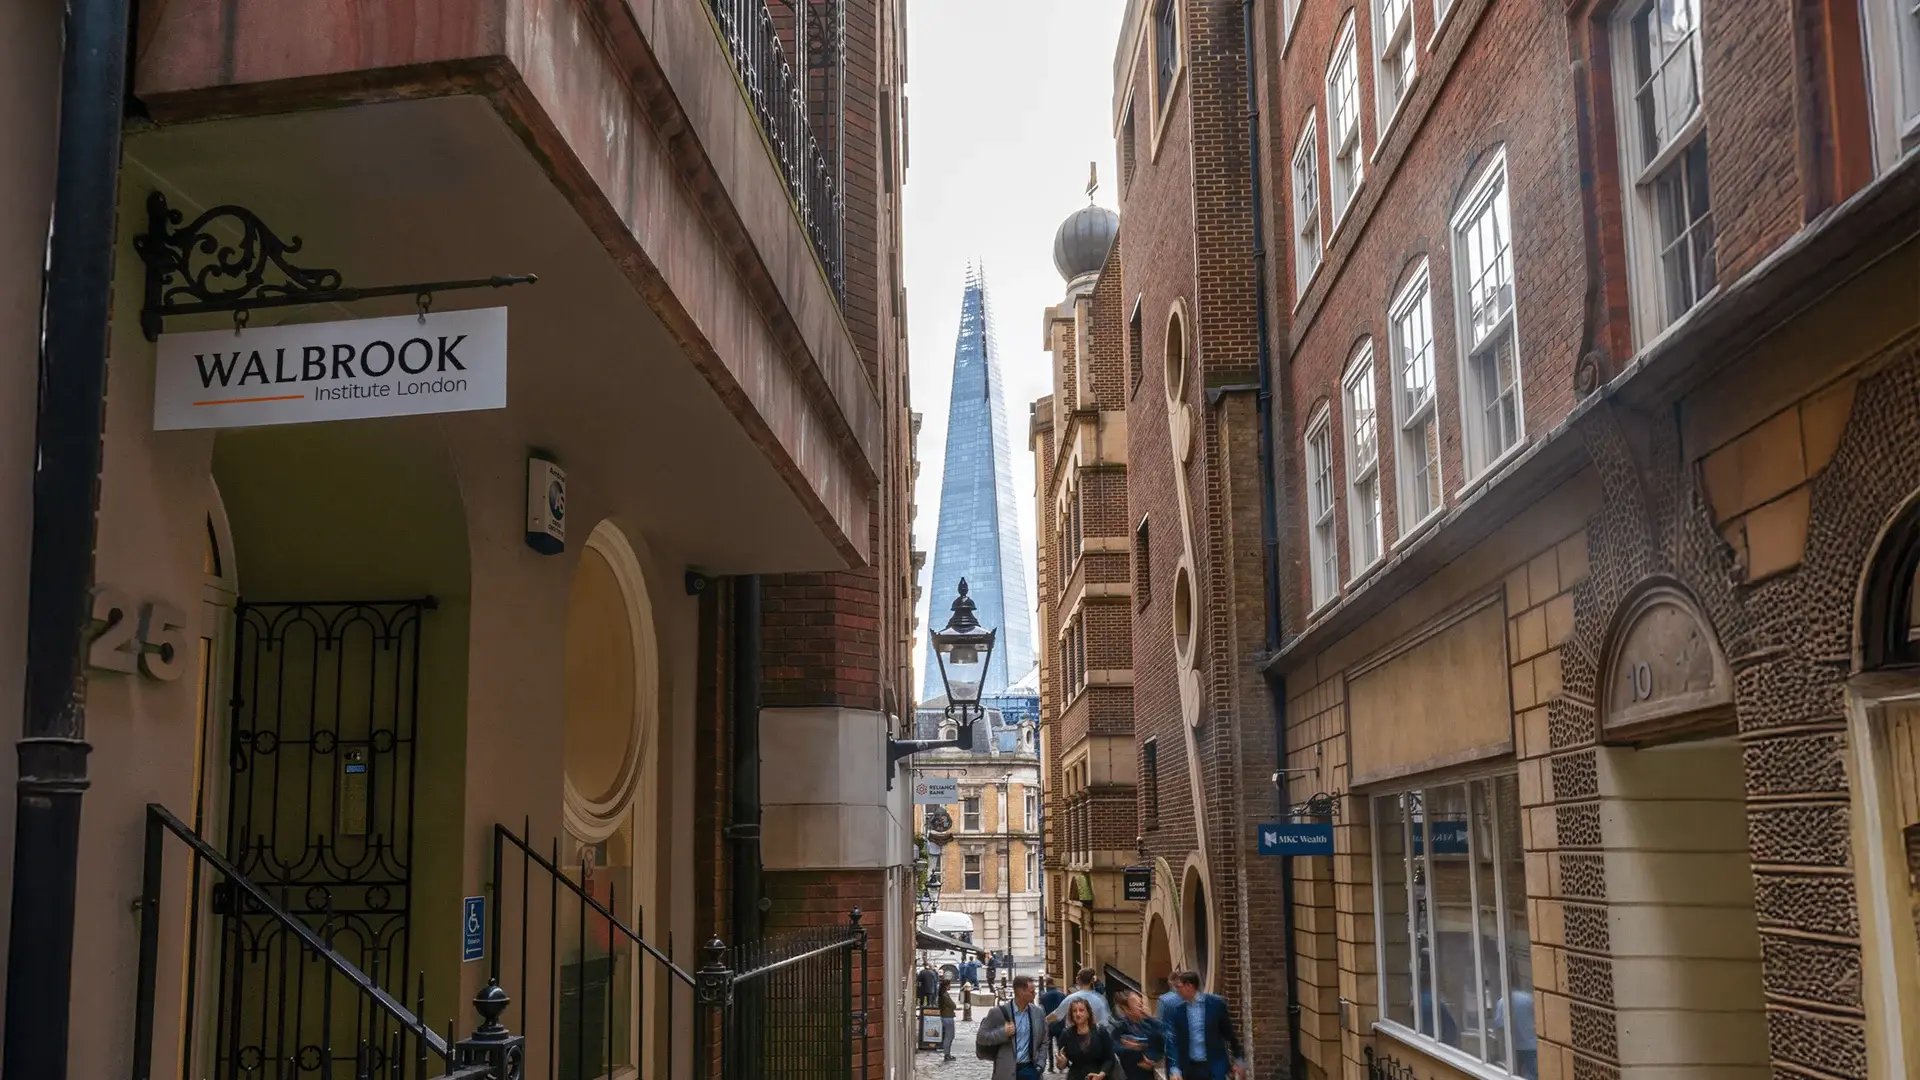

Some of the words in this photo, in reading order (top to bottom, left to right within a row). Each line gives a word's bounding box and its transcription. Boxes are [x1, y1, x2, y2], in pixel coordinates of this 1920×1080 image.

[194, 334, 468, 388] WALBROOK
[314, 382, 390, 401] Institute
[397, 376, 467, 396] London
[87, 586, 187, 681] 25
[1628, 661, 1653, 702] 10
[1279, 835, 1299, 844] MKC
[1300, 835, 1327, 844] Wealth
